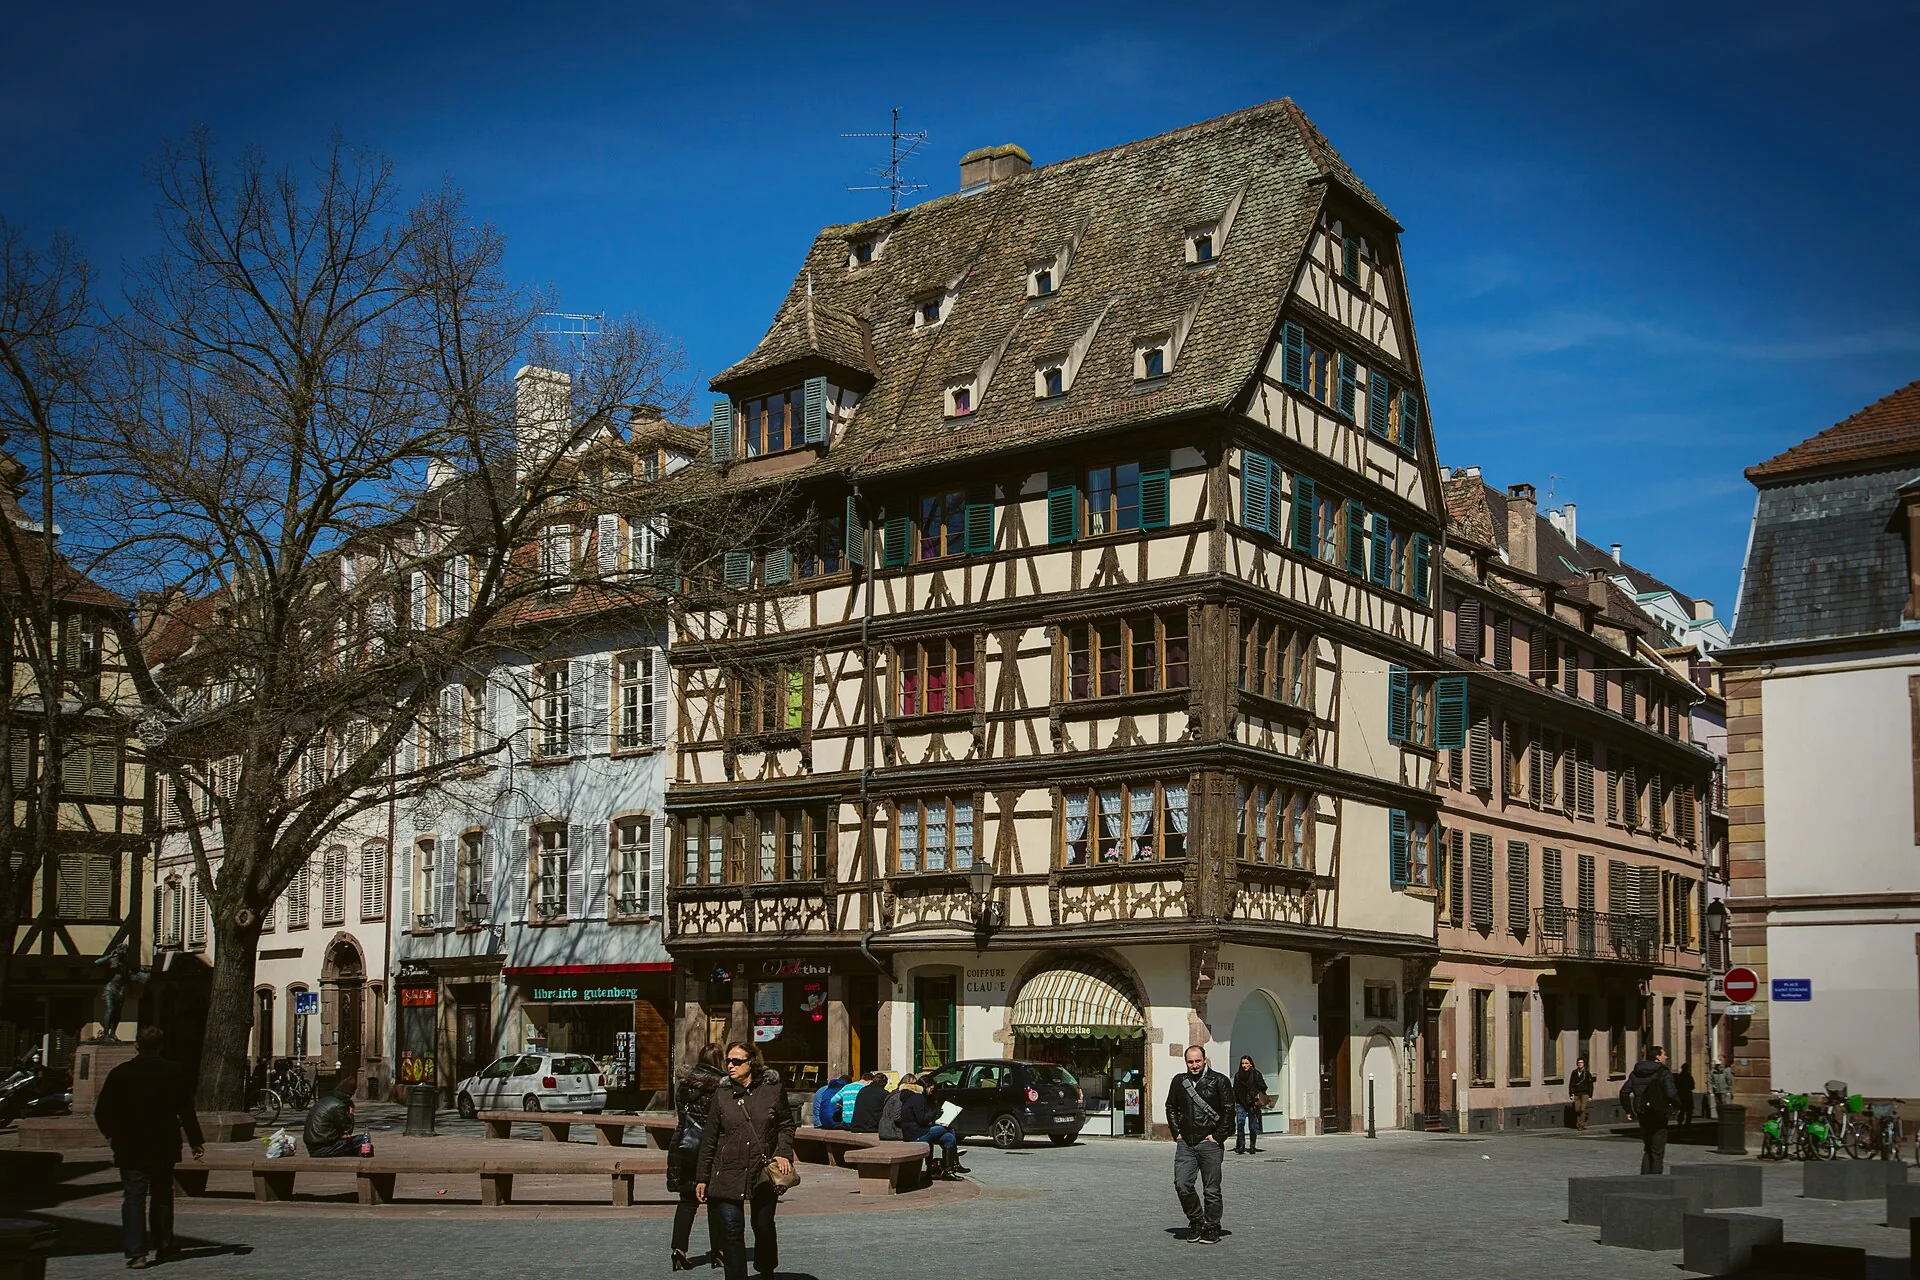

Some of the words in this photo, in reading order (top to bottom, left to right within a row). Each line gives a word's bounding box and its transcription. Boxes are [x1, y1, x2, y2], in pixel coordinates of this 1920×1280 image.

[966, 968, 1006, 978] COIFFURE
[966, 981, 1006, 992] CLAUE
[533, 987, 578, 999] librairie
[583, 986, 639, 1001] gutenberg
[1045, 1025, 1054, 1034] et
[1054, 1024, 1091, 1035] Christine
